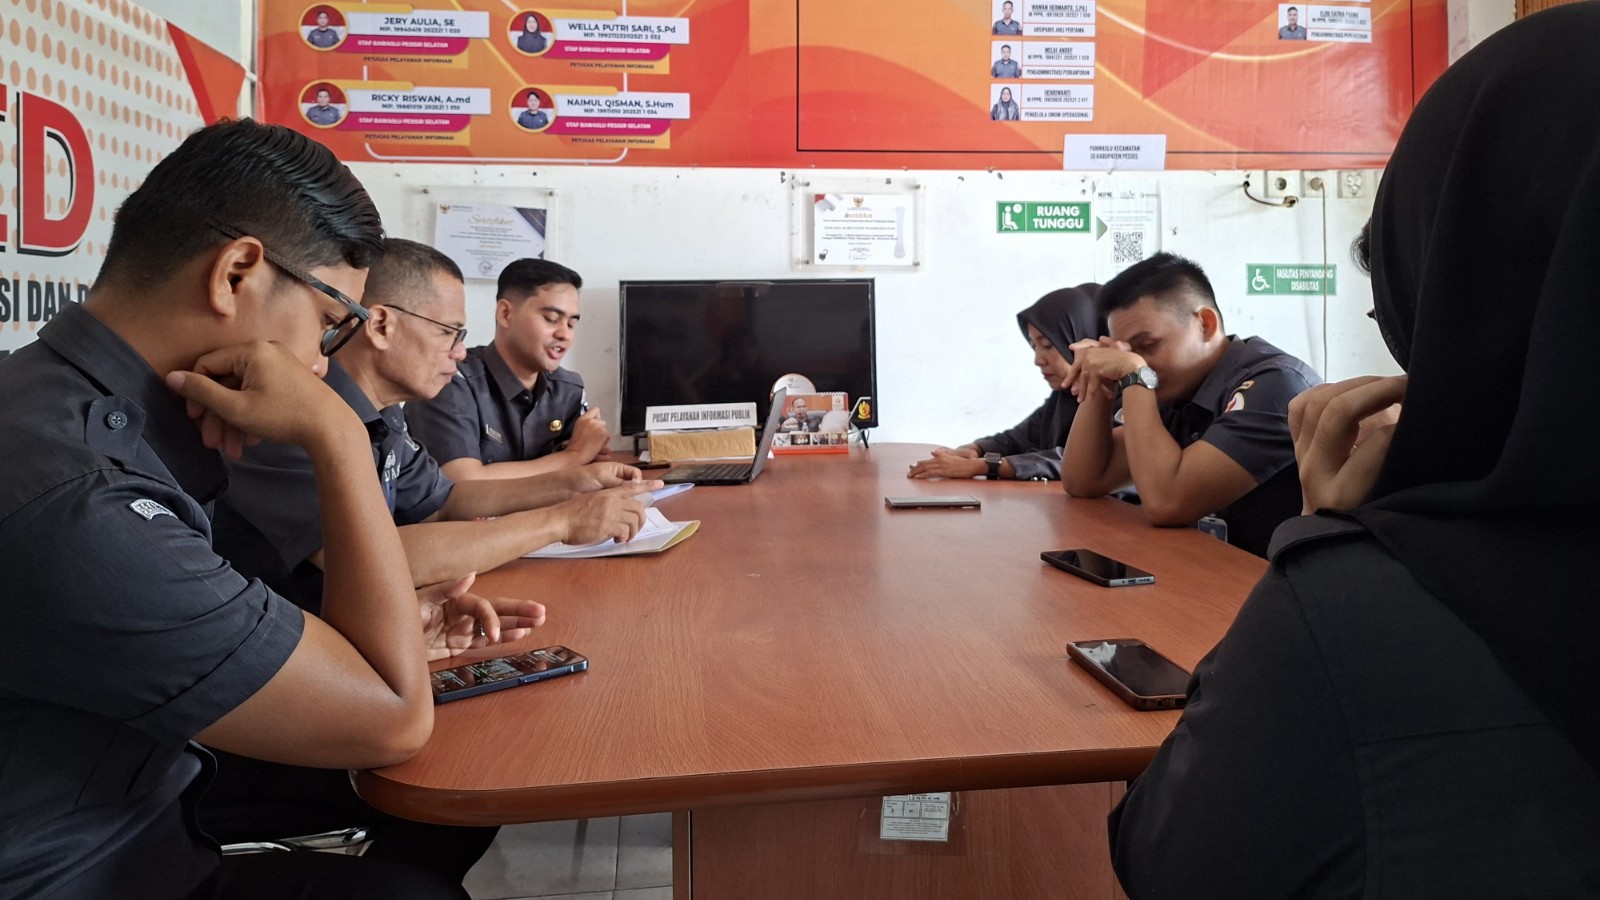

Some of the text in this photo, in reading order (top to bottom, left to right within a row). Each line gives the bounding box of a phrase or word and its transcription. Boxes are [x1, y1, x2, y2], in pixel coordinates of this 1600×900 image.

[410, 18, 442, 26] AULIA,
[602, 24, 629, 32] PUTRI
[631, 25, 654, 33] SARI,
[402, 95, 443, 104] RISWAN,
[605, 100, 643, 108] QISMAN,
[0, 83, 95, 257] D
[1036, 206, 1080, 217] RUANG
[1032, 218, 1084, 229] TUNGGU
[1276, 269, 1298, 279] FASILITAS
[1291, 281, 1319, 291] DISABILITAS
[28, 280, 70, 322] DAN
[652, 409, 750, 423] PUSAT PELAYANAN INFORMASI PUBLIK
